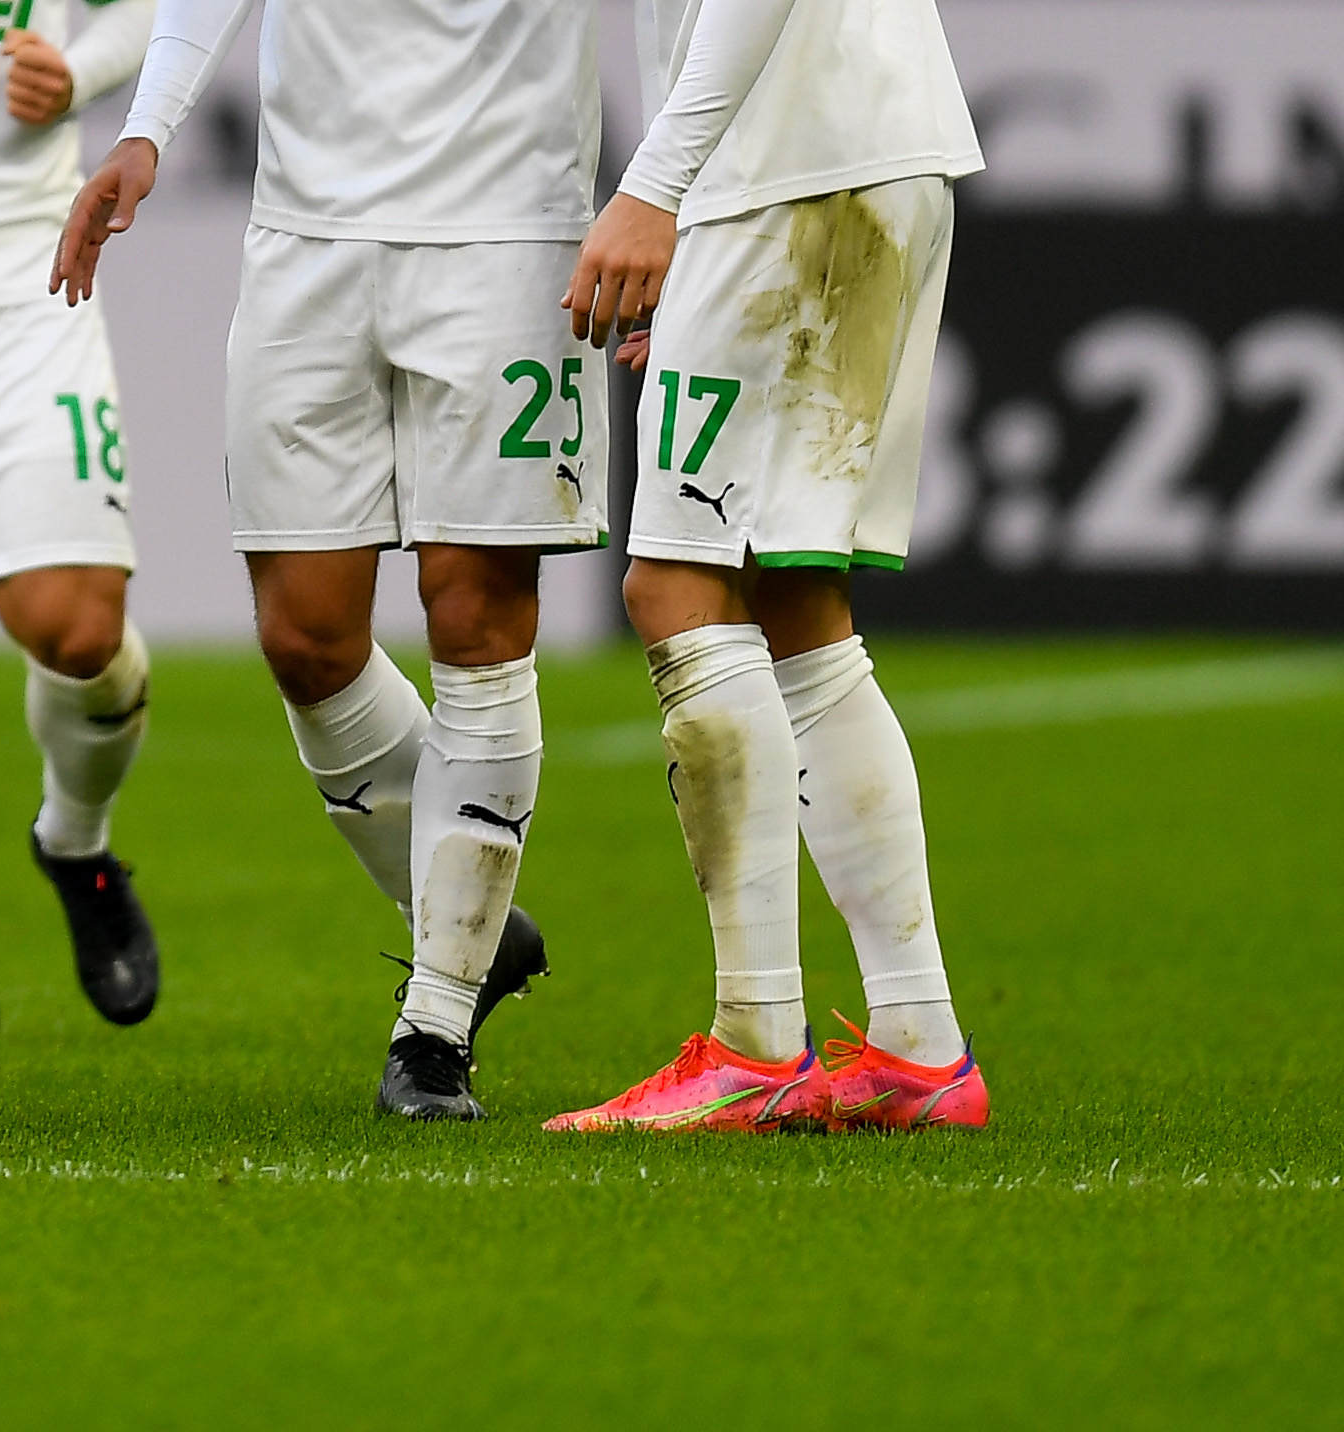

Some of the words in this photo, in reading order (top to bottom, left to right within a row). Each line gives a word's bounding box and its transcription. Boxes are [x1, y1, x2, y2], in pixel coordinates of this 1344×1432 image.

[55, 393, 125, 484] 18
[499, 357, 584, 459] 25
[658, 369, 742, 476] 17
